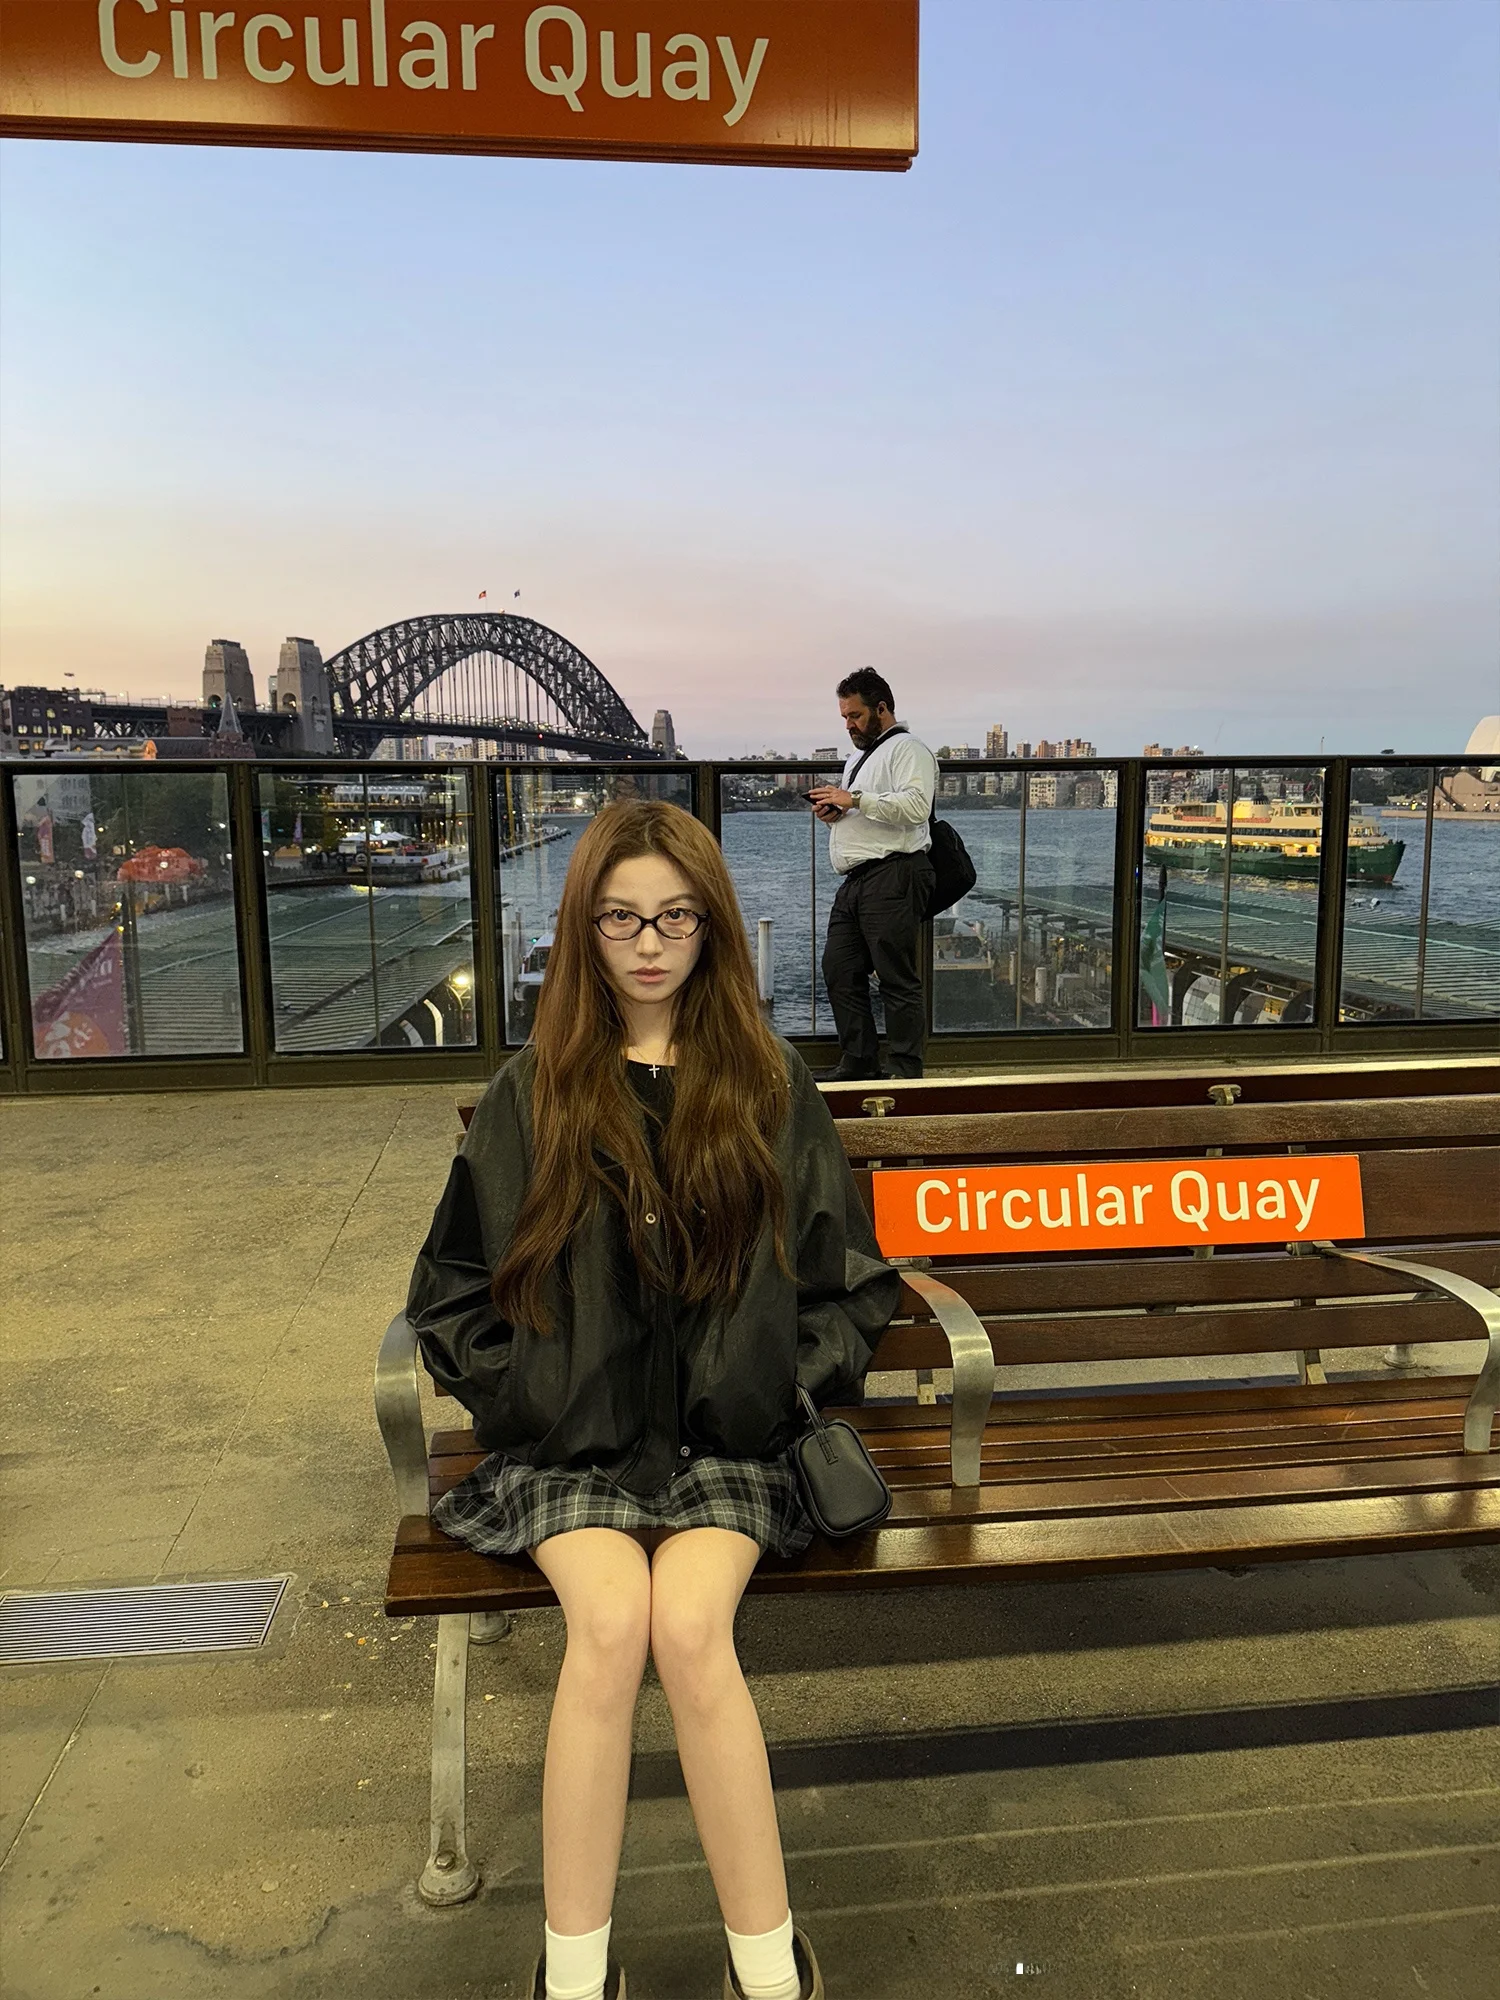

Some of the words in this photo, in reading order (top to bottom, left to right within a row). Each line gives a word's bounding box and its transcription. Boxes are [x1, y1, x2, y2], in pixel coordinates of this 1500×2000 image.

[98, 0, 495, 91] Circular
[524, 5, 770, 127] Quay
[916, 1173, 1153, 1233] Circular
[1170, 1170, 1320, 1232] Quay
